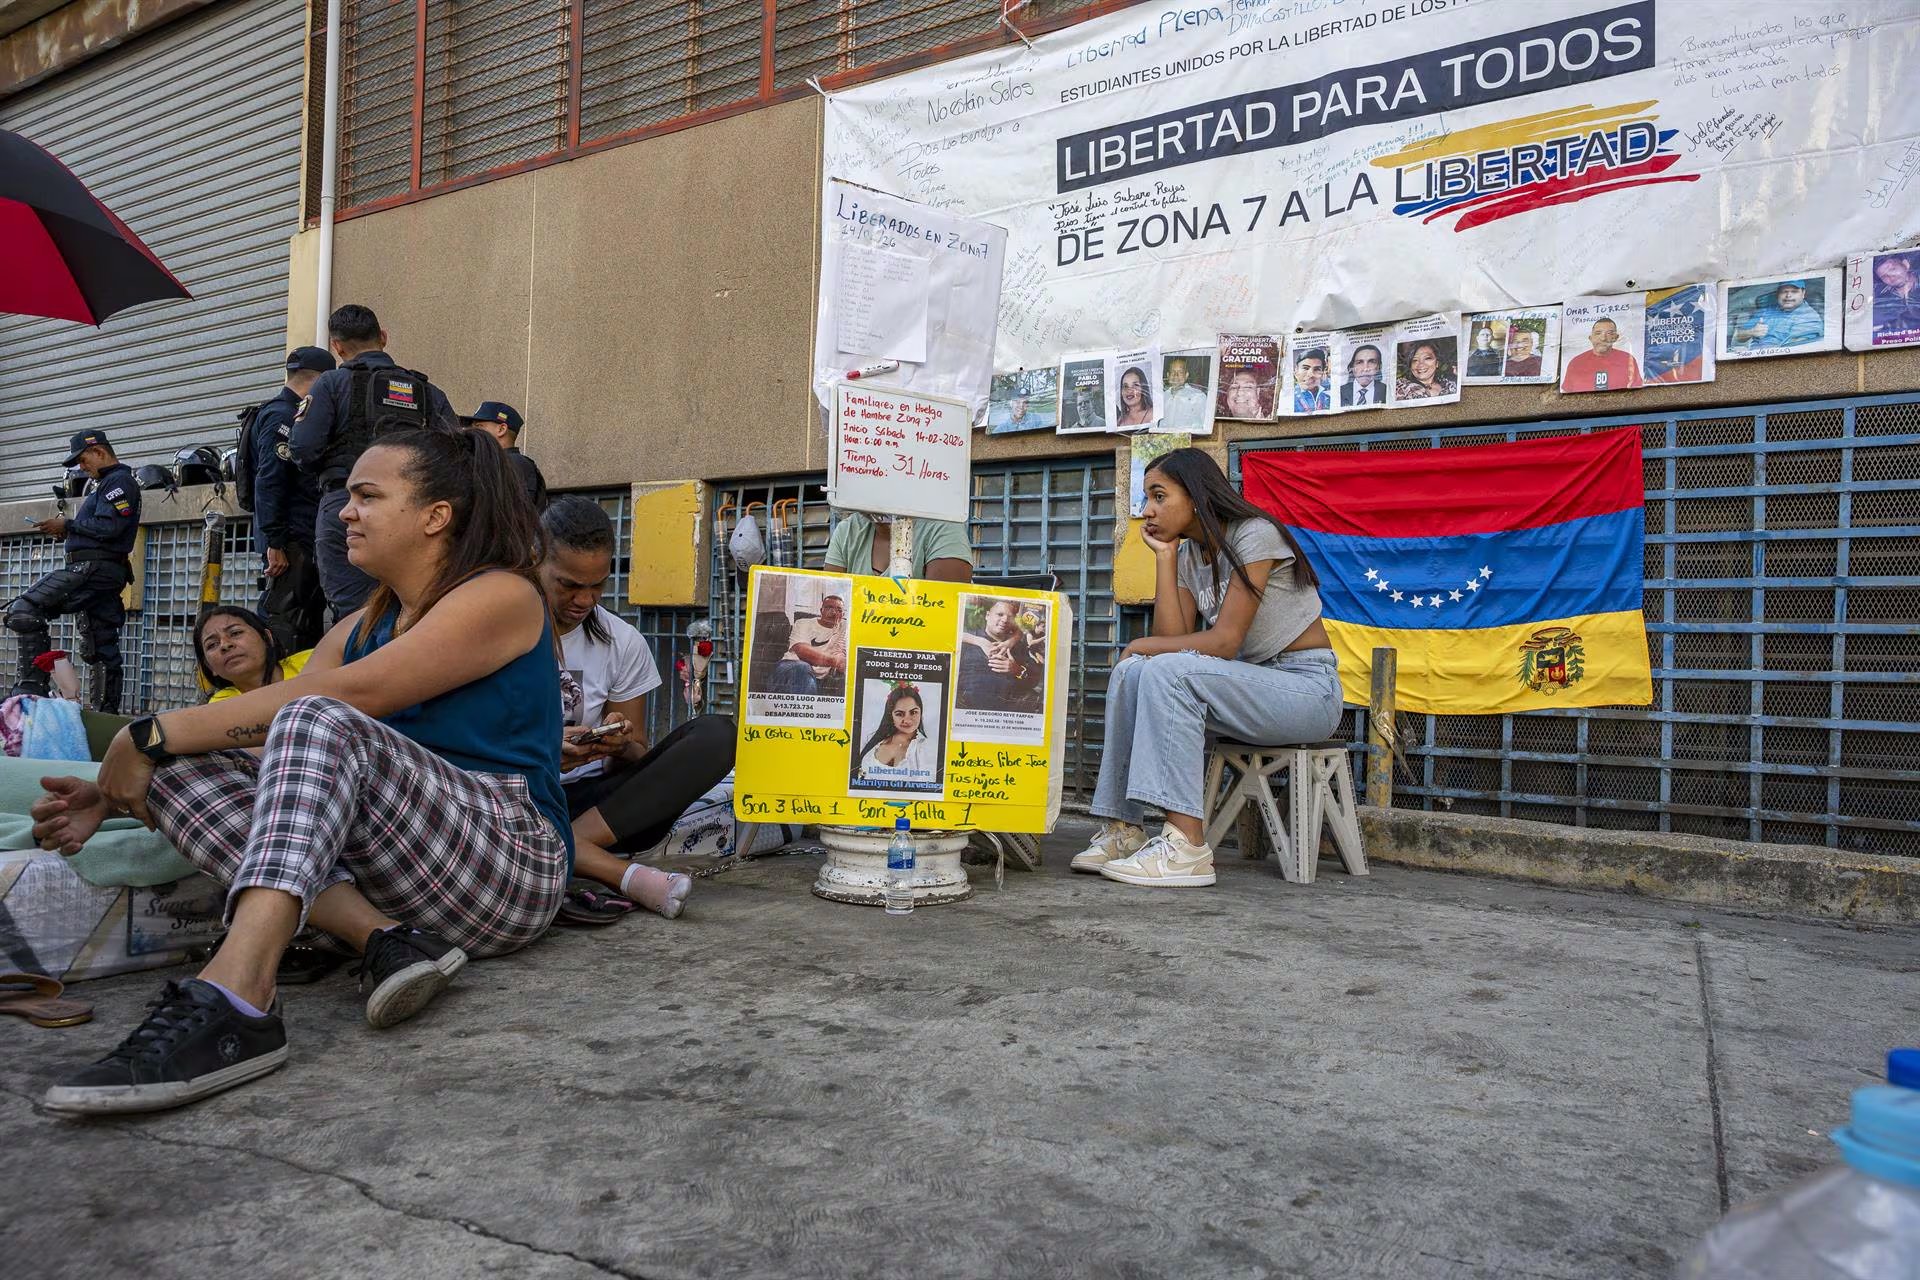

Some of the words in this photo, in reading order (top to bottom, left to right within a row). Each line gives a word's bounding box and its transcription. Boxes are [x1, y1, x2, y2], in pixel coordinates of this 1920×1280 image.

[1061, 66, 1162, 103] ESTUDIANTES
[1166, 51, 1225, 76] UNIDOS
[1230, 40, 1264, 60] POR
[1268, 35, 1290, 51] LA
[1294, 12, 1377, 46] LIBERTAD
[1382, 5, 1406, 24] DE
[1065, 102, 1276, 182] LIBERTAD
[1292, 67, 1427, 133] PARA
[1441, 17, 1642, 97] TODOS
[1057, 226, 1104, 266] DE
[1117, 203, 1231, 255] ZONA
[1242, 195, 1267, 232] 7
[1279, 190, 1310, 227] A
[1324, 172, 1379, 218] LA
[1395, 121, 1657, 203] LIBERTAD
[1085, 192, 1109, 212] Luis
[925, 230, 942, 245] EN
[1566, 306, 1589, 316] OMAR
[1651, 316, 1695, 326] LIBERTAD
[1666, 329, 1695, 337] PRESOS
[1222, 355, 1270, 363] GRATEROL
[1075, 379, 1100, 387] CAMPOS
[1595, 372, 1608, 385] BD
[843, 406, 856, 418] de
[896, 412, 921, 427] Zona
[924, 416, 931, 427] 7
[915, 402, 943, 420] Huelga
[843, 423, 868, 435] Inicio
[843, 449, 877, 468] Tiempo
[892, 453, 915, 476] 31
[873, 650, 913, 661] LIBERTAD
[916, 653, 937, 662] PARA
[866, 660, 890, 669] TODOS
[894, 662, 910, 671] LOS
[913, 663, 943, 672] PRESOS
[879, 669, 924, 681] POLÍTICOS
[748, 692, 767, 701] JEAN
[767, 693, 795, 702] CARLOS
[795, 694, 813, 703] LUGO
[812, 695, 845, 705] ARROYO
[764, 710, 815, 720] DESAPARECIDO
[867, 766, 908, 777] Libertad
[909, 769, 931, 778] para
[775, 799, 787, 814] 3
